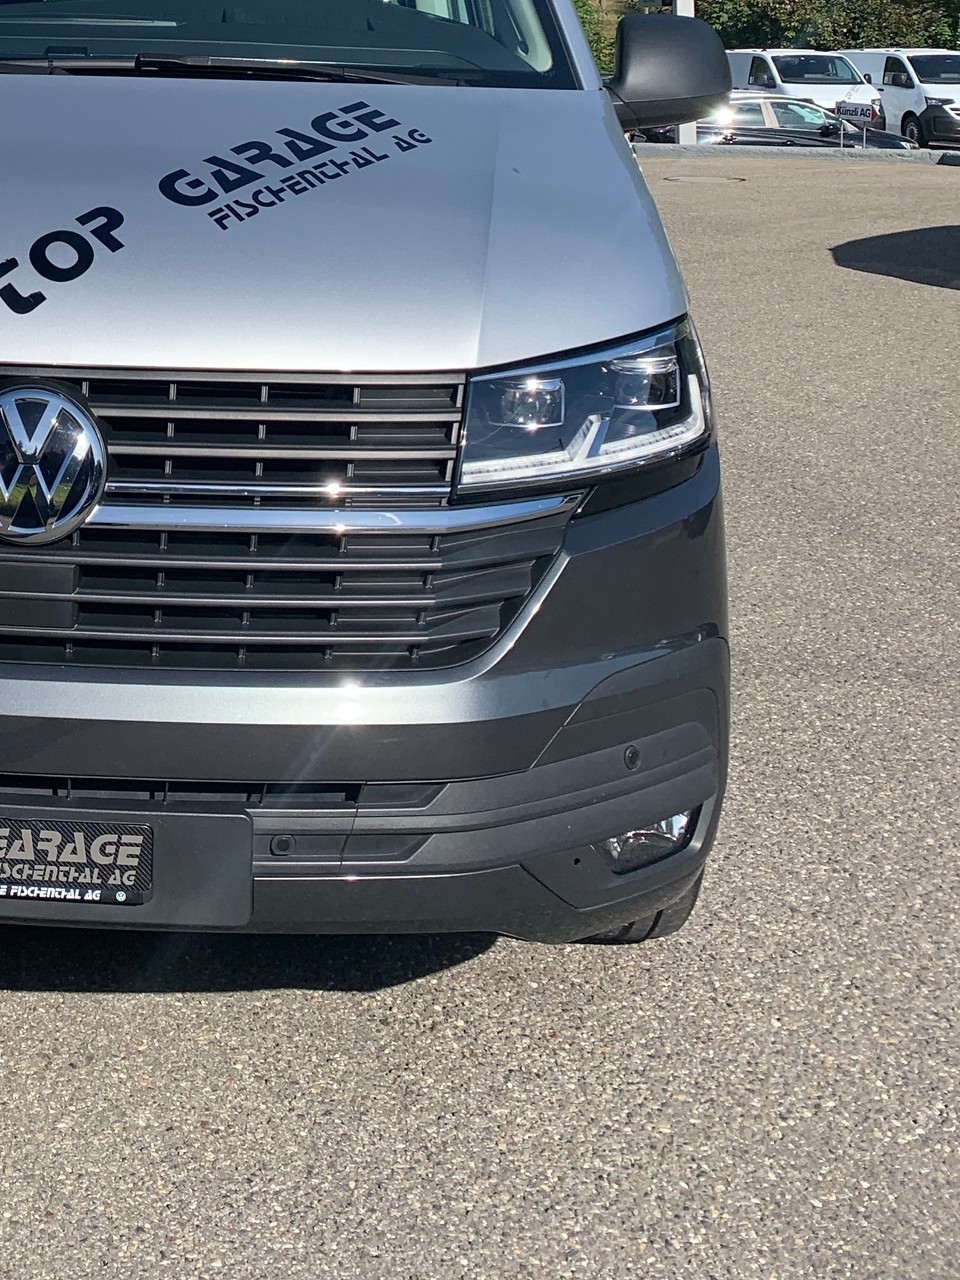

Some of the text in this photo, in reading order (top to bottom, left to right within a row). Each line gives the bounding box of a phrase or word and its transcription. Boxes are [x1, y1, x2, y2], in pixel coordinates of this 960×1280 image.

[836, 105, 871, 118] Künzli AG
[157, 100, 403, 207] GARAGE
[206, 127, 434, 231] FISCHENTHAL AG
[106, 869, 137, 886] AG
[9, 885, 82, 900] FISCHENTHAL
[83, 889, 102, 901] AG
